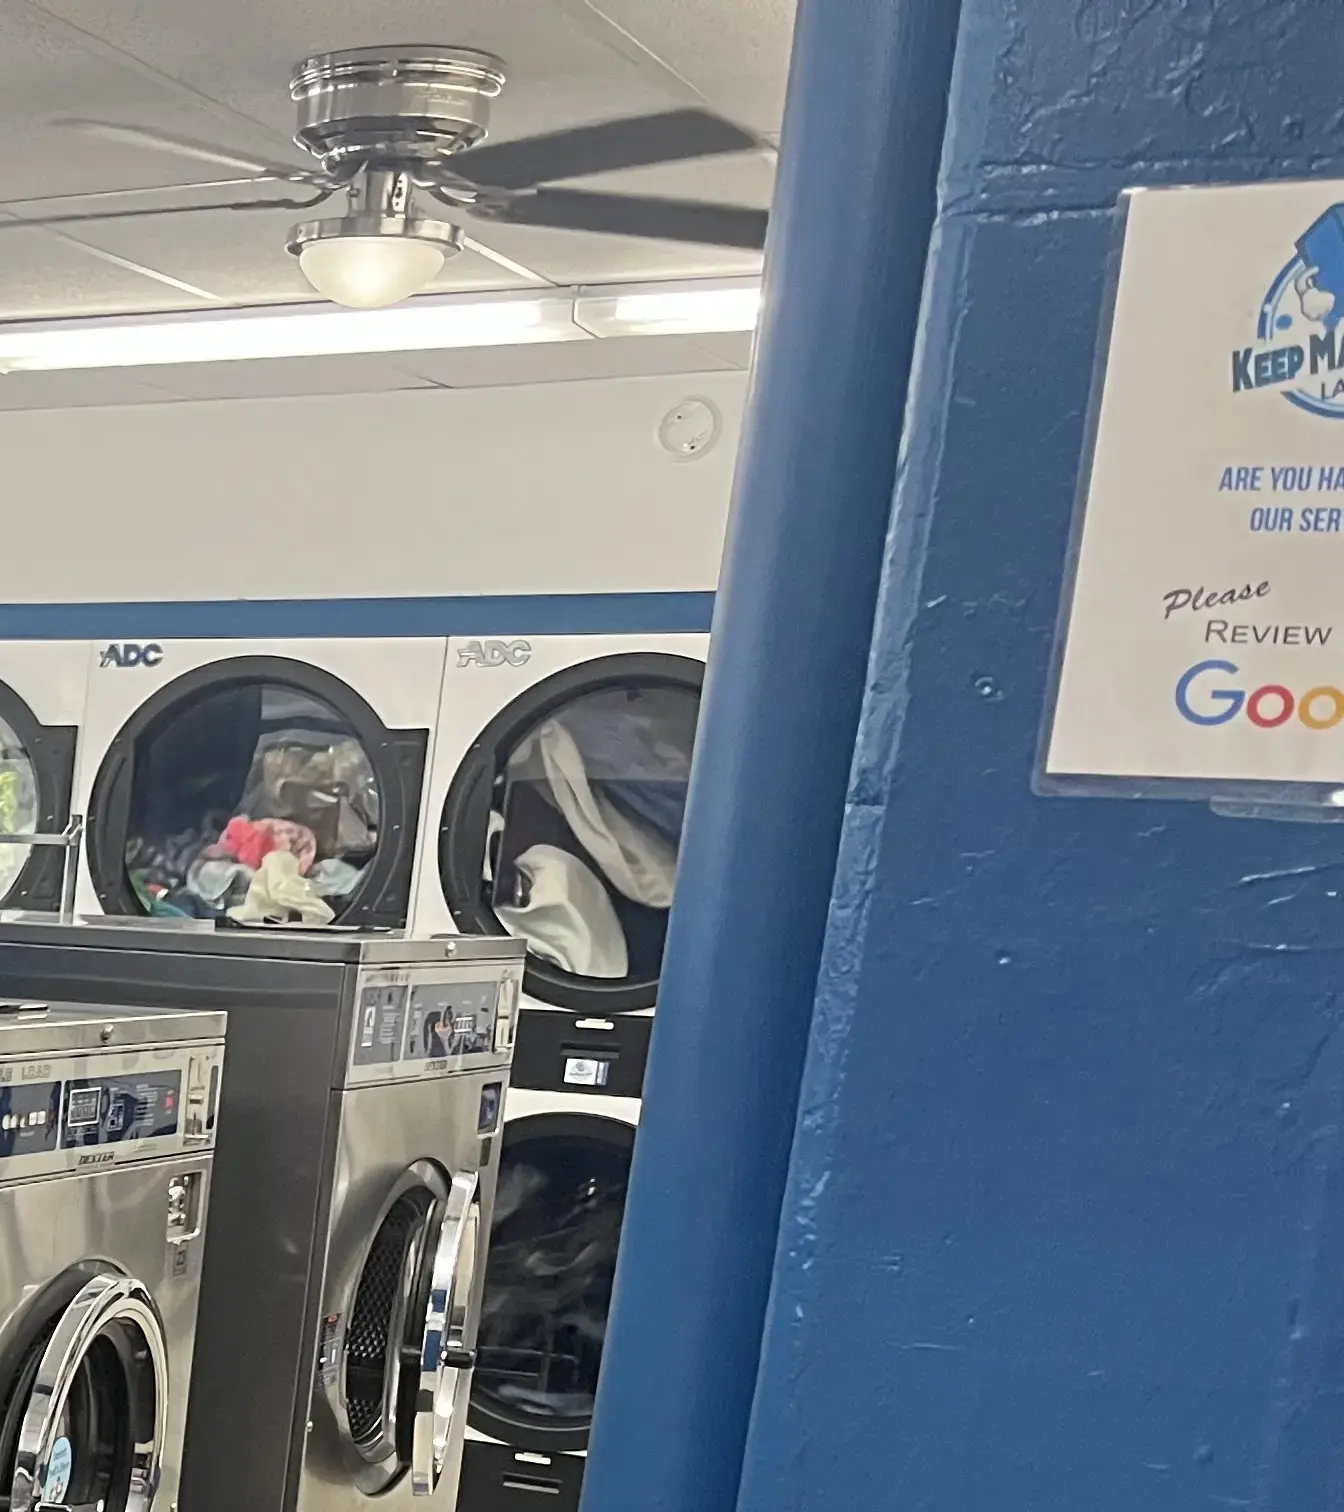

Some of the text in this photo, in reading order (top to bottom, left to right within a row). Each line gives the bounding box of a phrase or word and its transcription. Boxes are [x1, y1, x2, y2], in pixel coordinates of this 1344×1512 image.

[1232, 344, 1305, 393] KEEP
[1218, 466, 1344, 491] ARE YOU HA
[1250, 507, 1342, 532] OUR SER
[1163, 580, 1271, 620] Please
[1205, 619, 1333, 646] REVIEW
[99, 643, 164, 668] ADC
[457, 640, 532, 667] ADC
[1175, 659, 1344, 731] Goo
